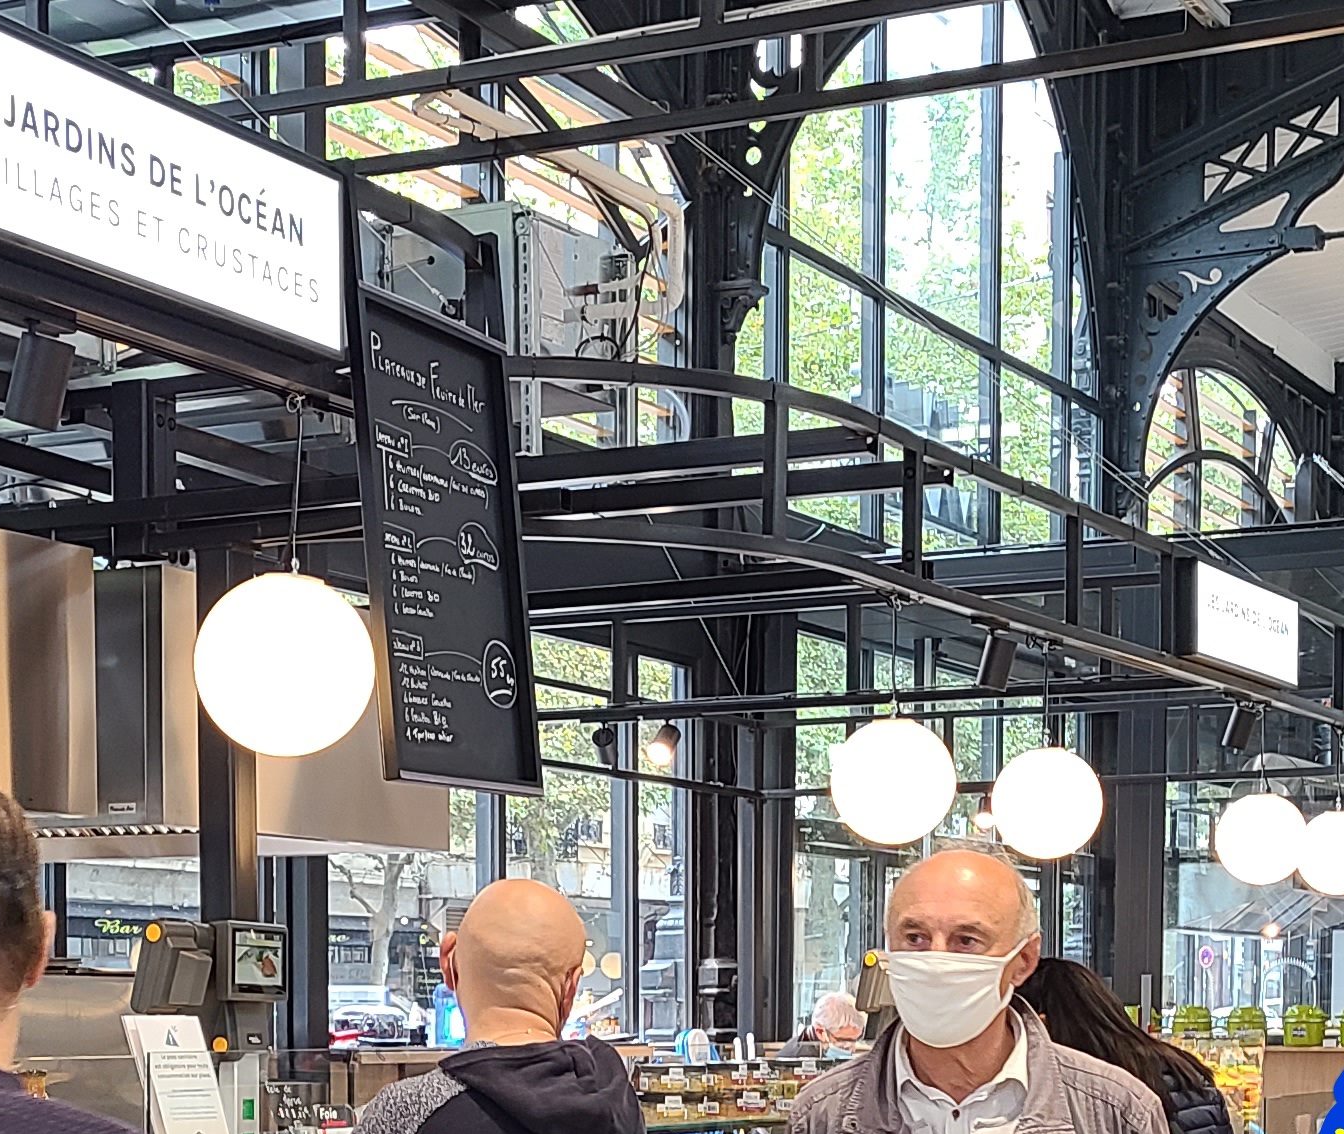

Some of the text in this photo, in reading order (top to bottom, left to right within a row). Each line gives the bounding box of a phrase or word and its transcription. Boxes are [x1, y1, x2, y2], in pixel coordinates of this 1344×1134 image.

[3, 94, 137, 177] JARDINS
[148, 153, 184, 198] DE
[195, 172, 306, 247] L'OCÉAN
[137, 209, 165, 243] ET
[177, 227, 320, 304] CRUSTACES
[94, 919, 143, 935] Bar
[319, 1107, 338, 1120] Foie
